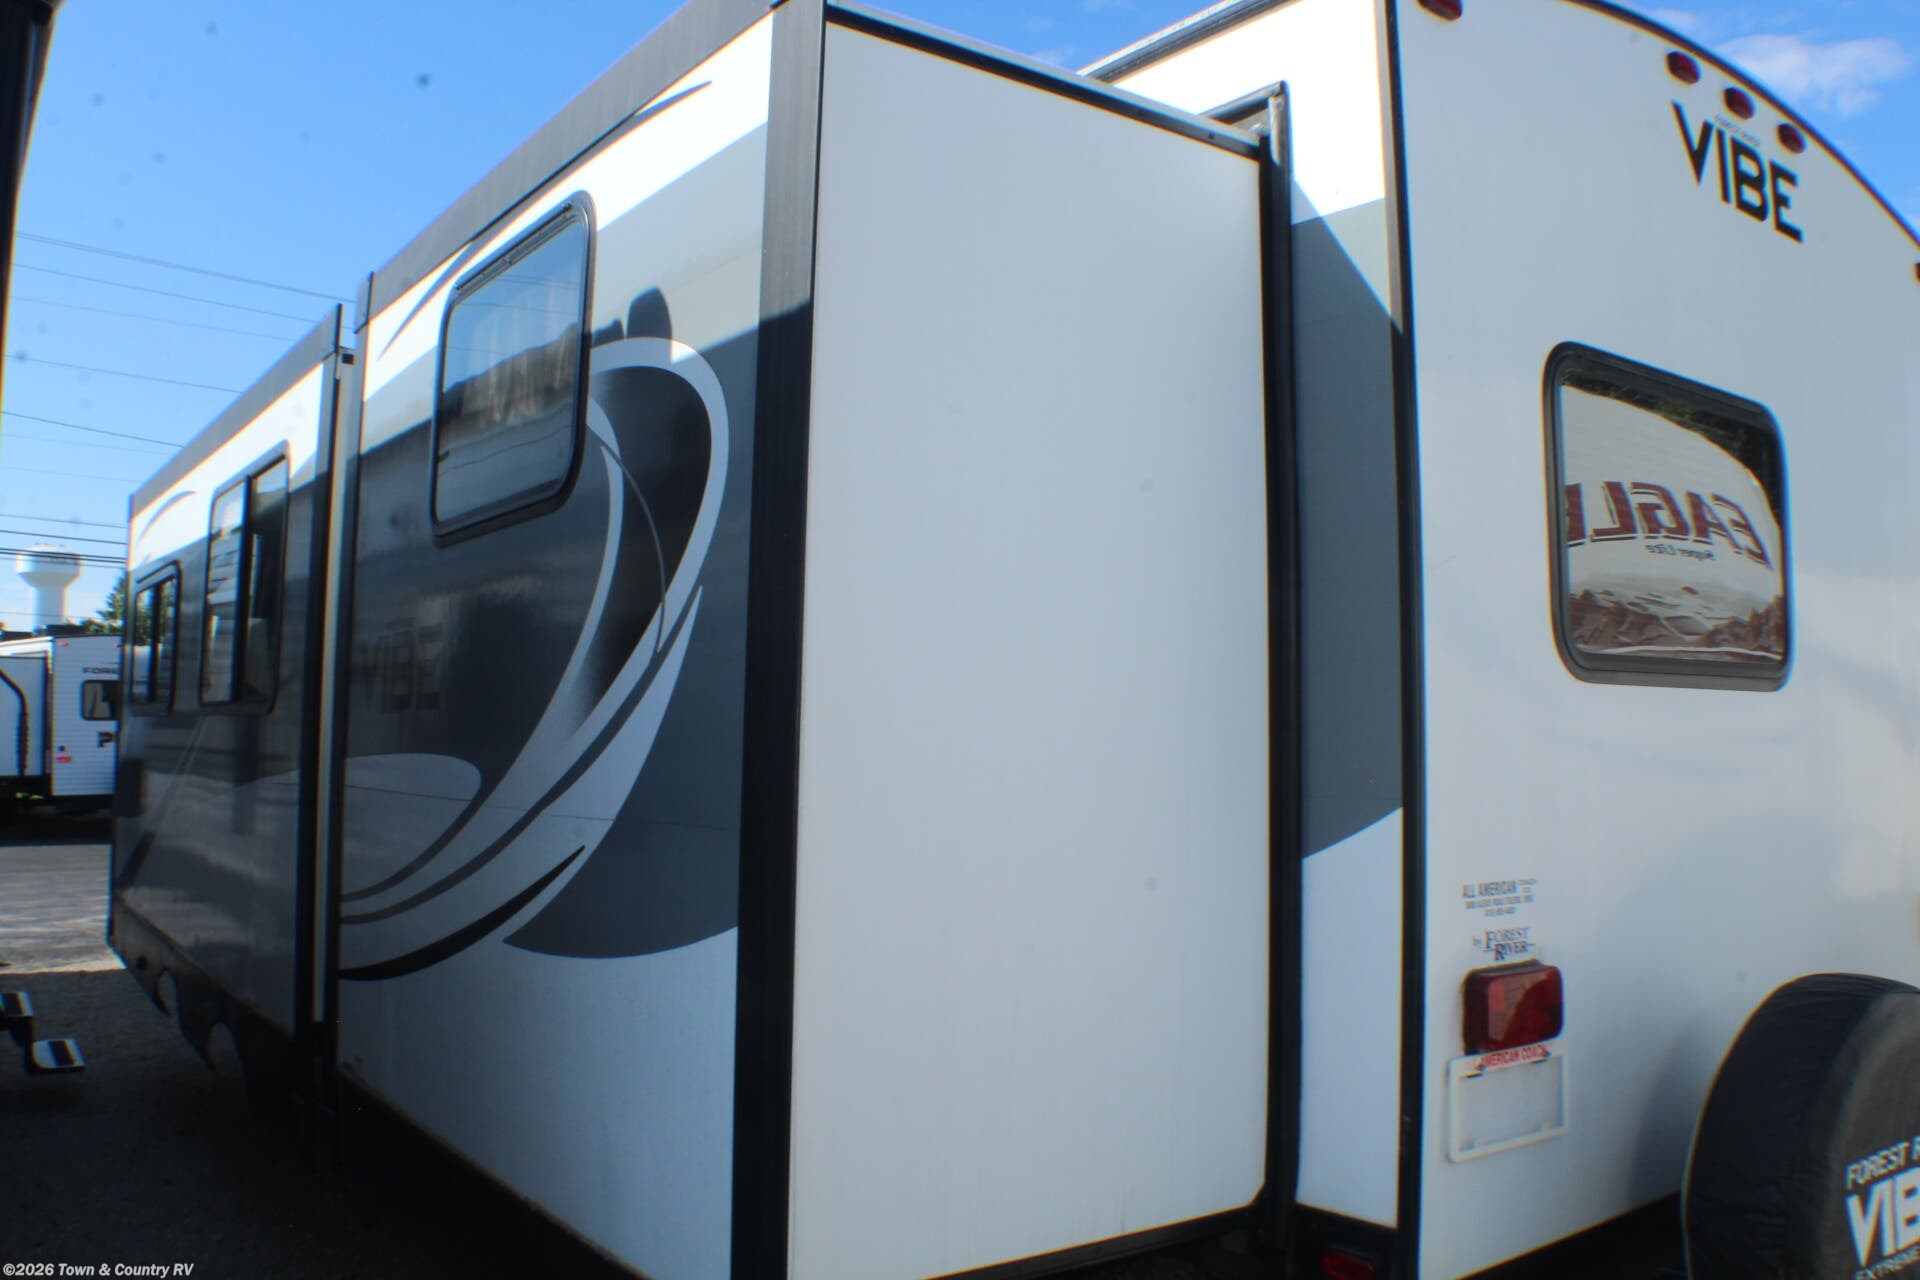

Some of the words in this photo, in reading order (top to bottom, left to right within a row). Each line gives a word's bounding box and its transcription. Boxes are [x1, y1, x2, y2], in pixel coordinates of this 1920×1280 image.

[1671, 100, 1804, 243] VIBE
[1478, 879, 1517, 897] AMERICAN
[1484, 927, 1530, 949] FOREST
[1494, 940, 1530, 961] RIVER
[1845, 1141, 1910, 1190] FOREST
[1845, 1166, 1920, 1267] VIB
